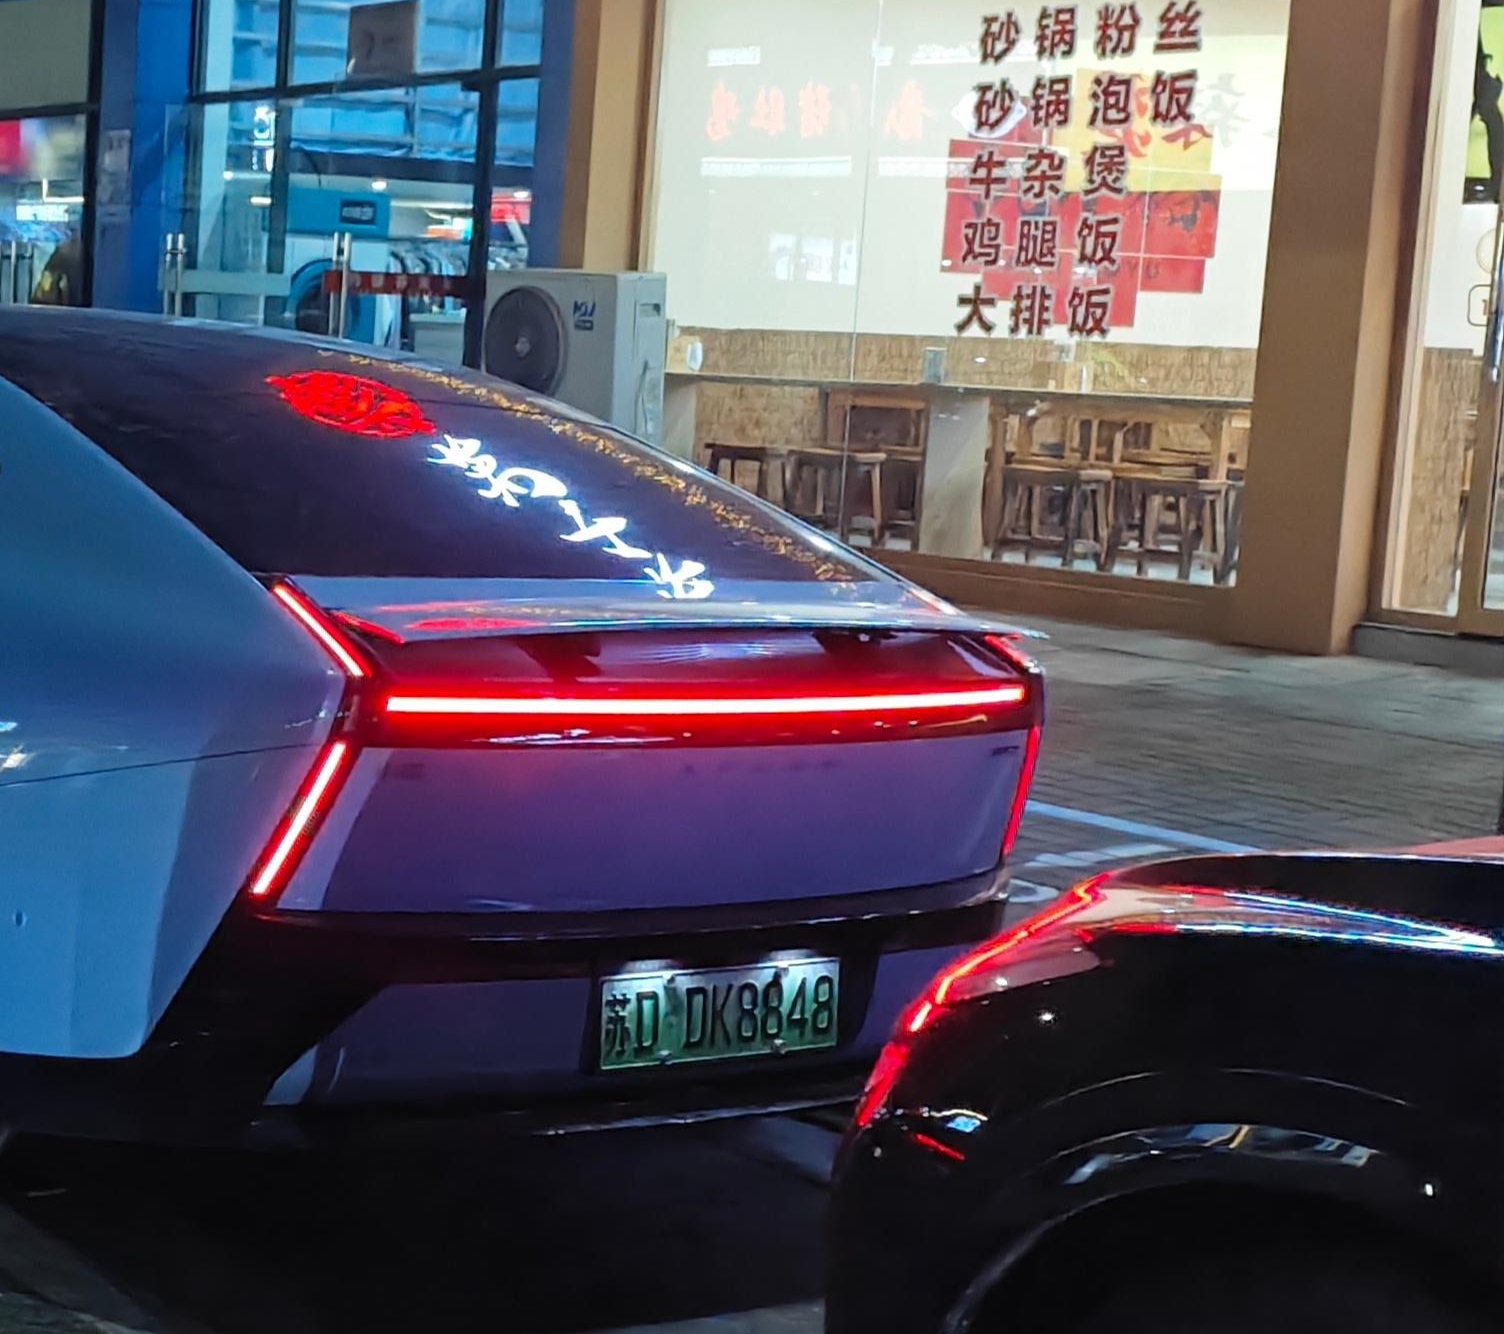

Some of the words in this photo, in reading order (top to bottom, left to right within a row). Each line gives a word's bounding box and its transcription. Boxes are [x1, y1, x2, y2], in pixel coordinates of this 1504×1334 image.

[980, 0, 1202, 65] 砂锅粉丝
[973, 69, 1198, 133] 砂锅泡饭
[969, 145, 1128, 200] 牛杂煲
[961, 215, 1121, 269] 鸡腿饭
[955, 284, 1112, 338] 大排饭
[683, 975, 833, 1049] DK8848
